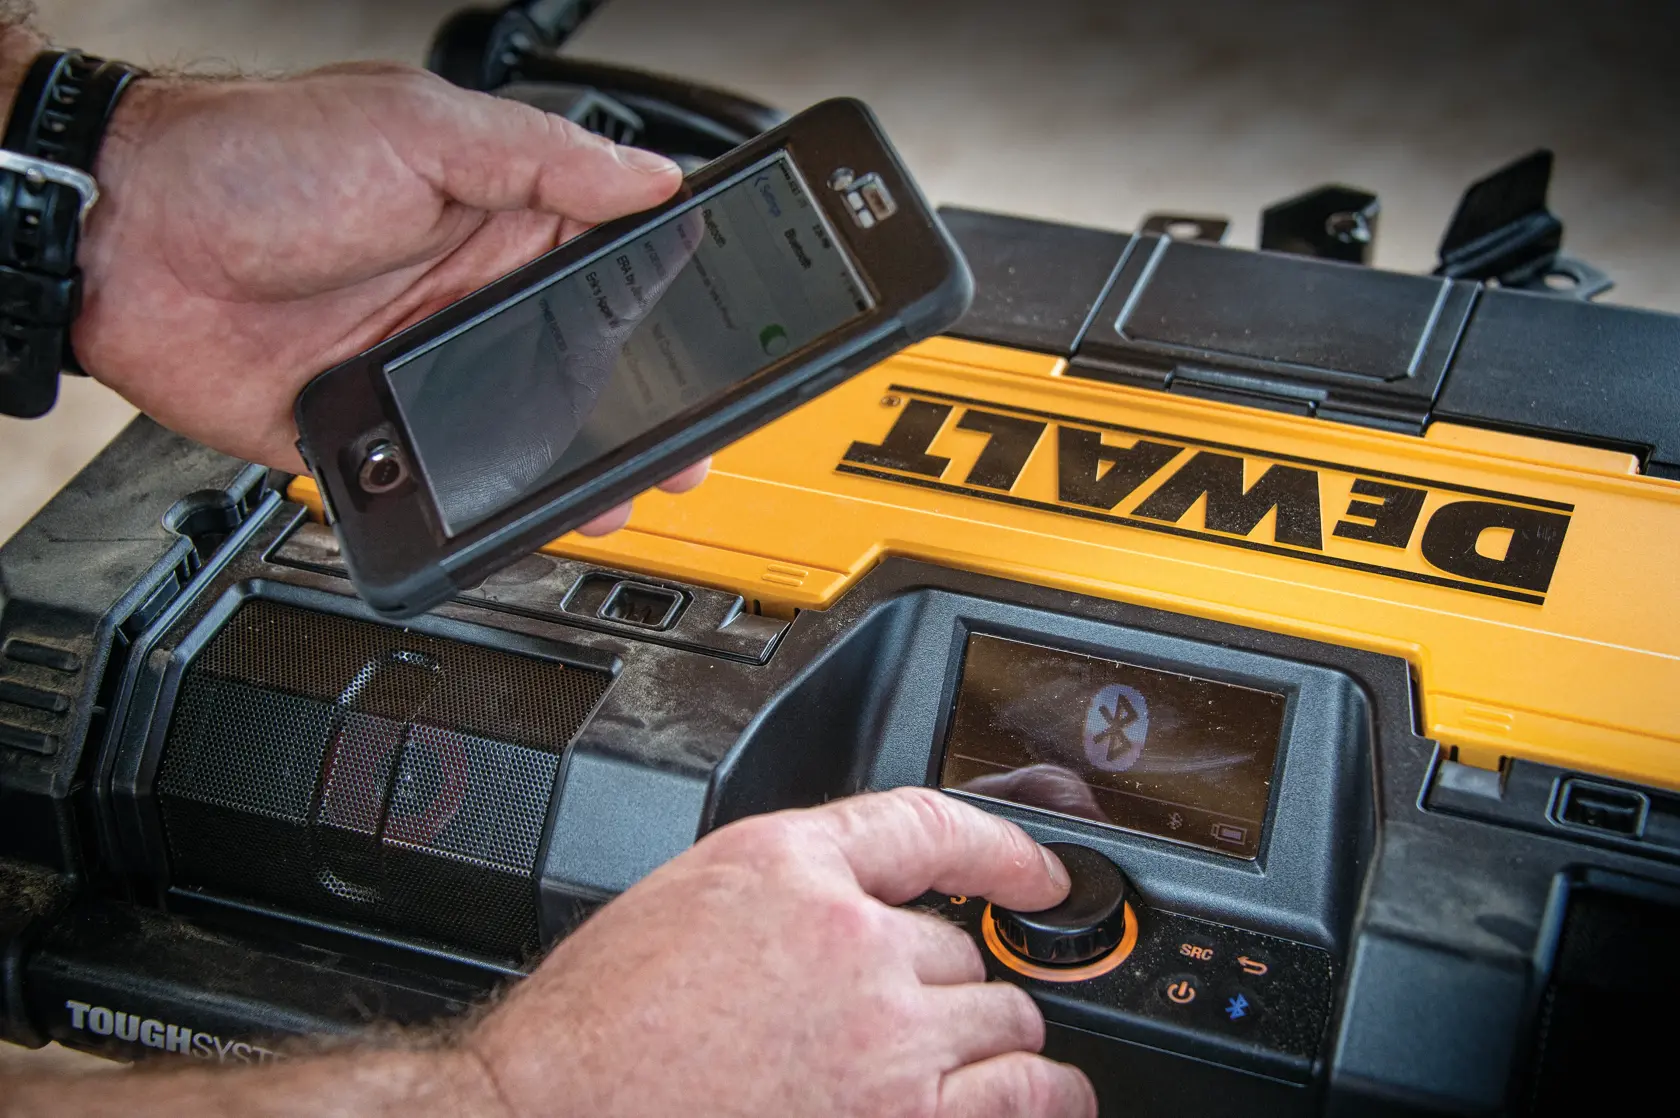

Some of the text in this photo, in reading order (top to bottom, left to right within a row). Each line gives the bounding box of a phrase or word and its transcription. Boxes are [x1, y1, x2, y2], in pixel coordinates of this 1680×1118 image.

[784, 228, 813, 270] Bluetooth
[838, 398, 1572, 593] DEWALT
[1179, 943, 1214, 960] SRC
